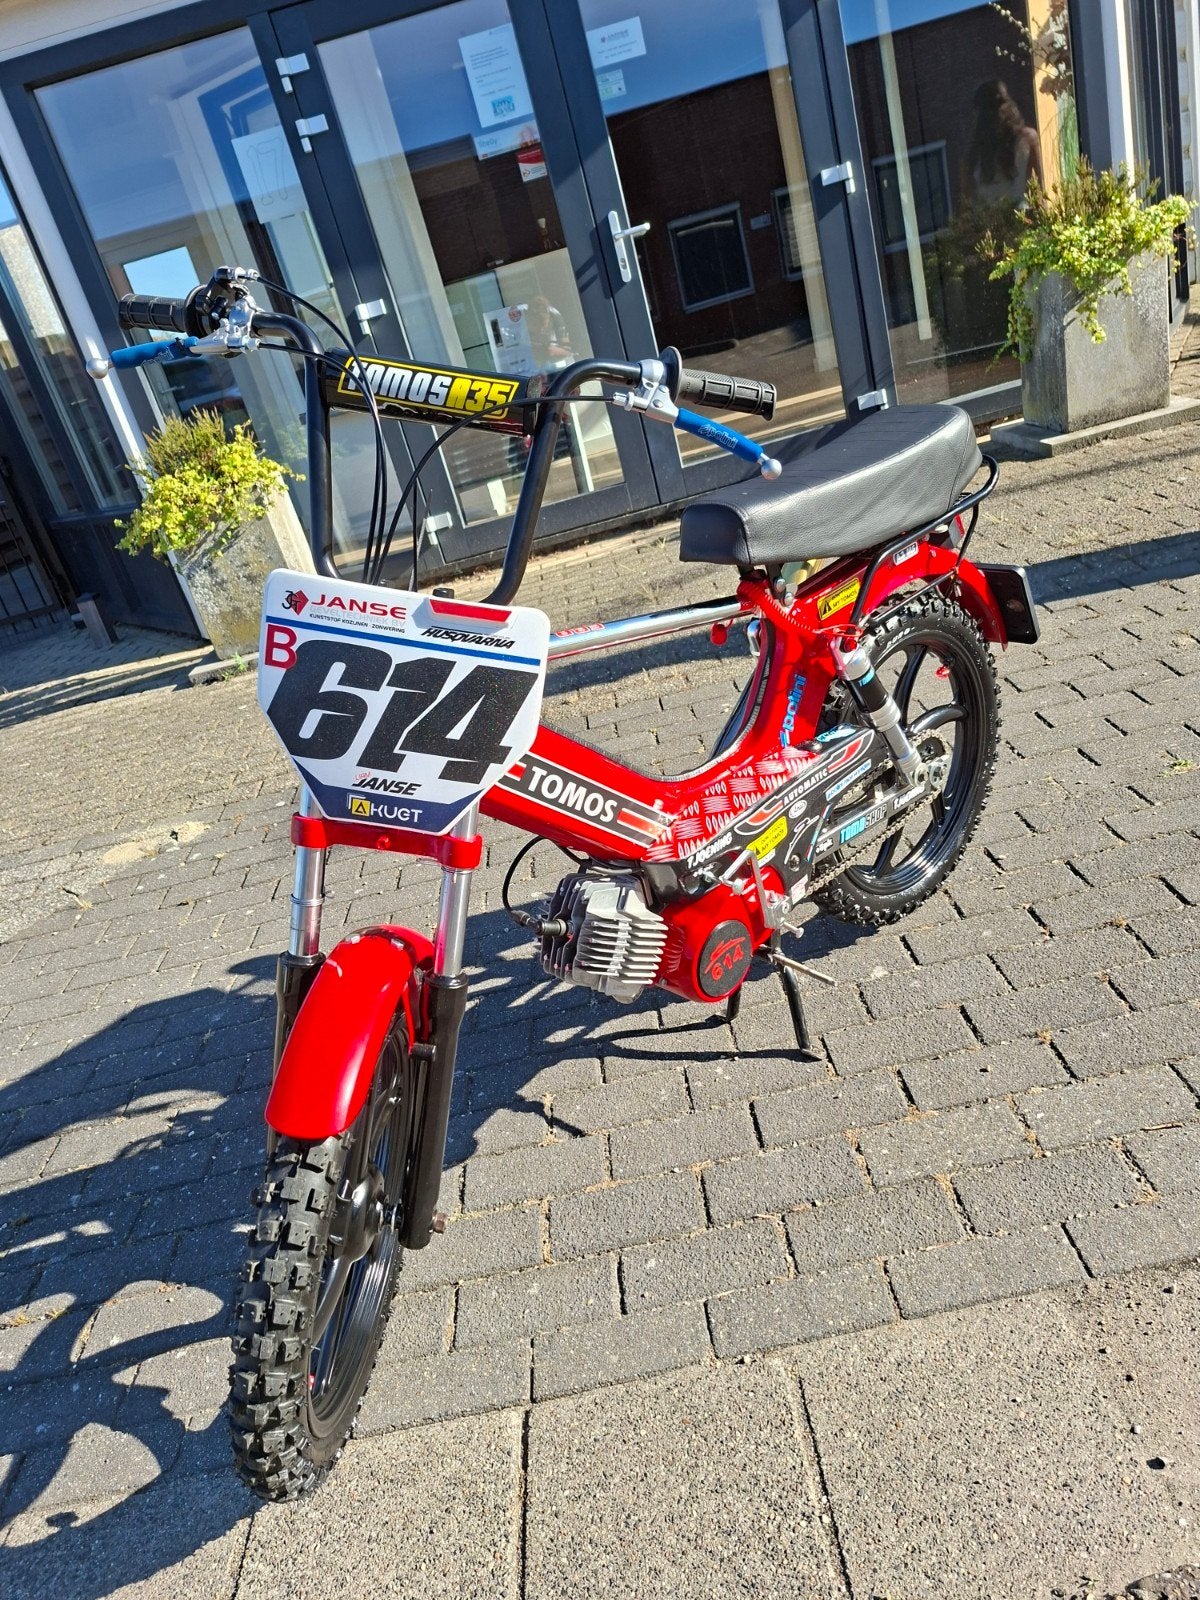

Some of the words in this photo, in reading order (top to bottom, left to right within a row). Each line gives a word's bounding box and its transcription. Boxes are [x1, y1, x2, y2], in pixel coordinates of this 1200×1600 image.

[309, 613, 341, 623] KUNSTSTOF
[371, 623, 406, 634] ZONWERING
[311, 594, 407, 620] JANSE
[264, 624, 297, 670] B
[421, 628, 516, 649] HUSQVARNA
[267, 639, 539, 784] 614
[783, 674, 807, 732] polini
[351, 777, 422, 796] JANSE
[527, 766, 618, 823] TOMOS
[783, 767, 828, 806] AUTOMATIC
[711, 944, 744, 981] 614
